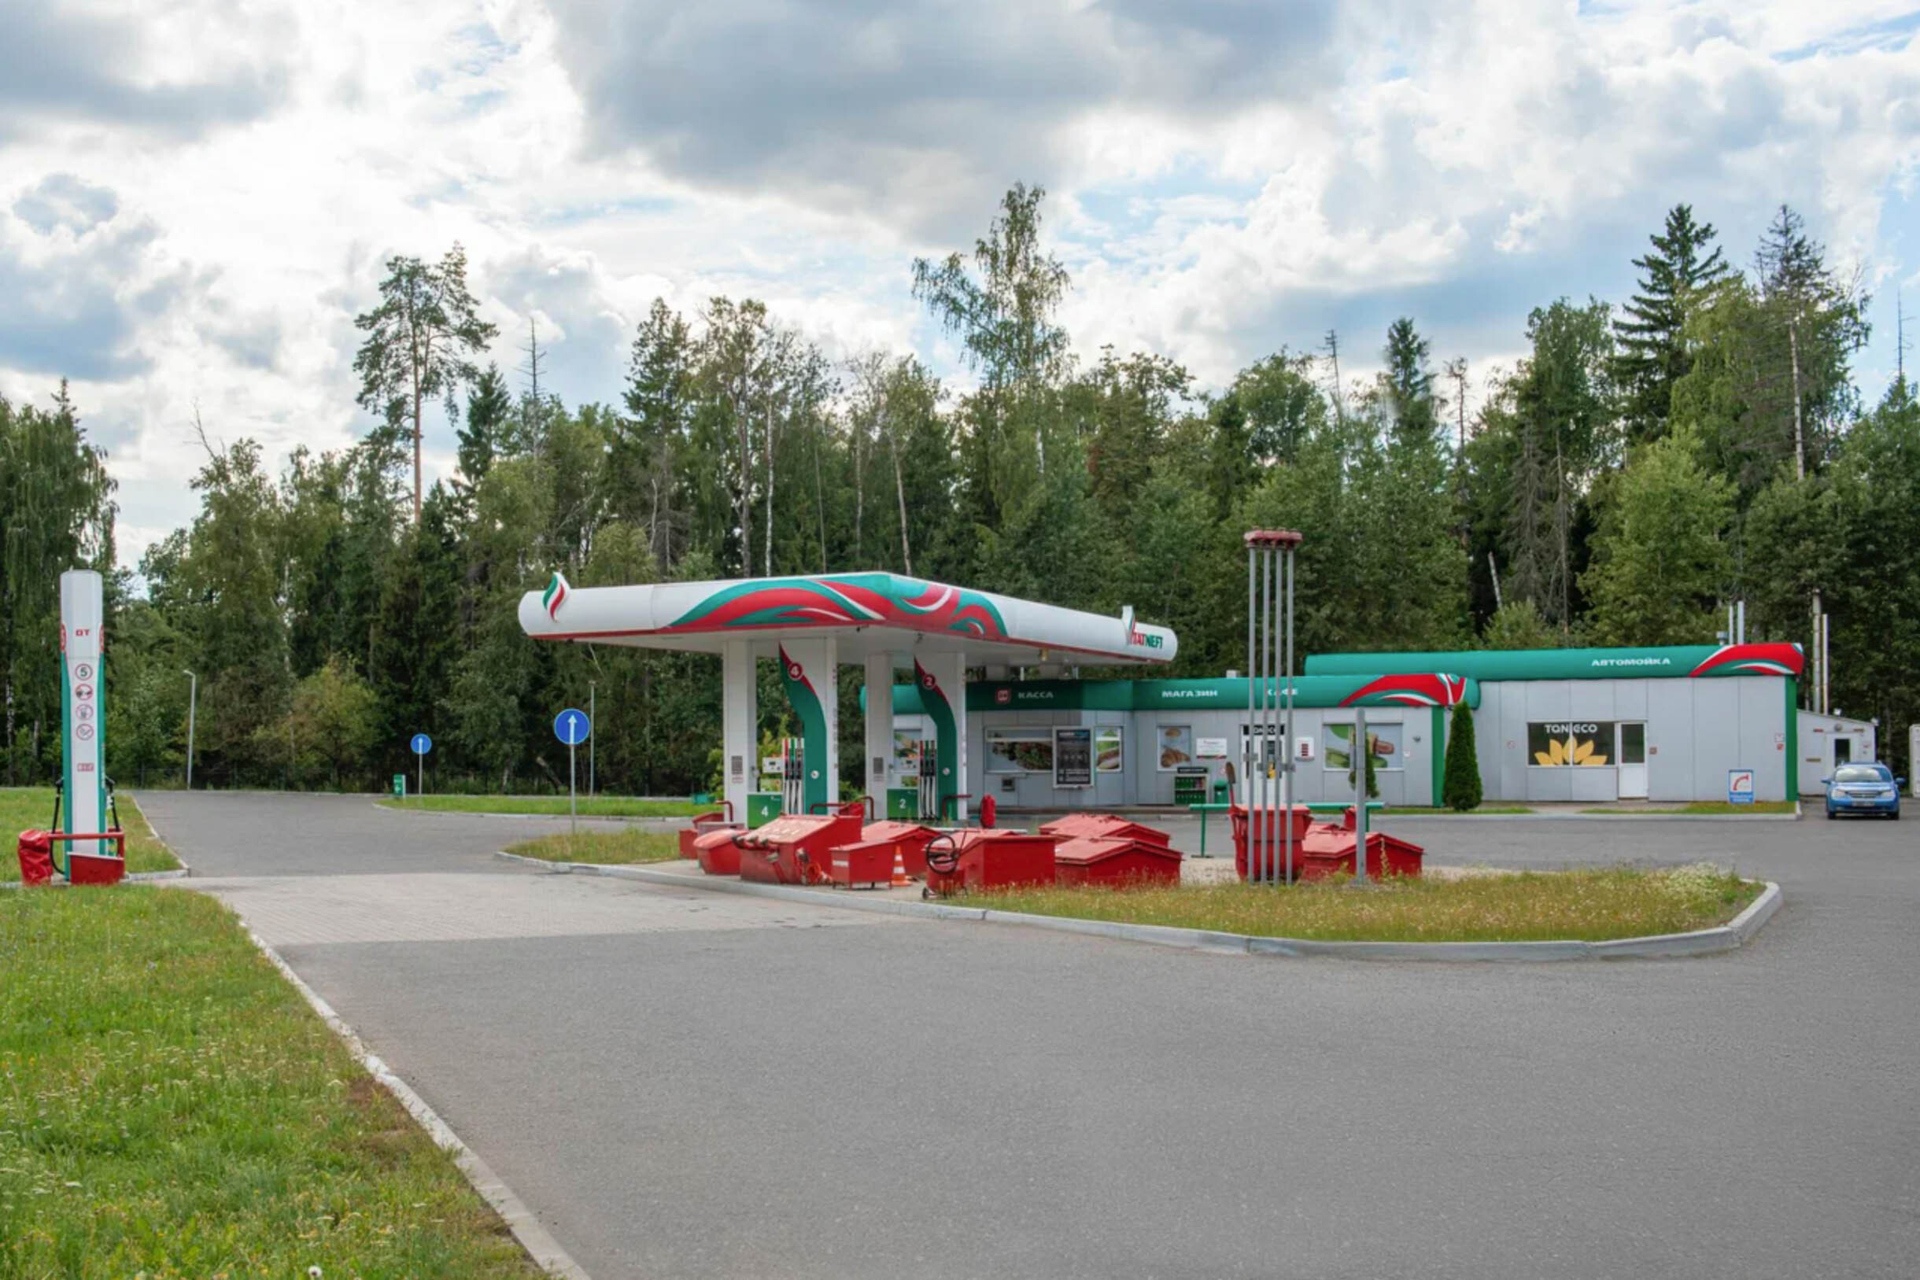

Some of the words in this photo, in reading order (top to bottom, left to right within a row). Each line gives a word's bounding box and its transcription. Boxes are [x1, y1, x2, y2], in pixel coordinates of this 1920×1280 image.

[1591, 657, 1671, 667] АВТОМОЙКА
[80, 667, 88, 677] 5
[791, 667, 799, 675] 4
[926, 677, 933, 686] 2
[1018, 691, 1054, 699] КАССА
[1161, 690, 1218, 698] МАГАЗИН
[1265, 688, 1299, 697] КФЕ
[899, 799, 906, 809] 2
[761, 806, 769, 817] 4
